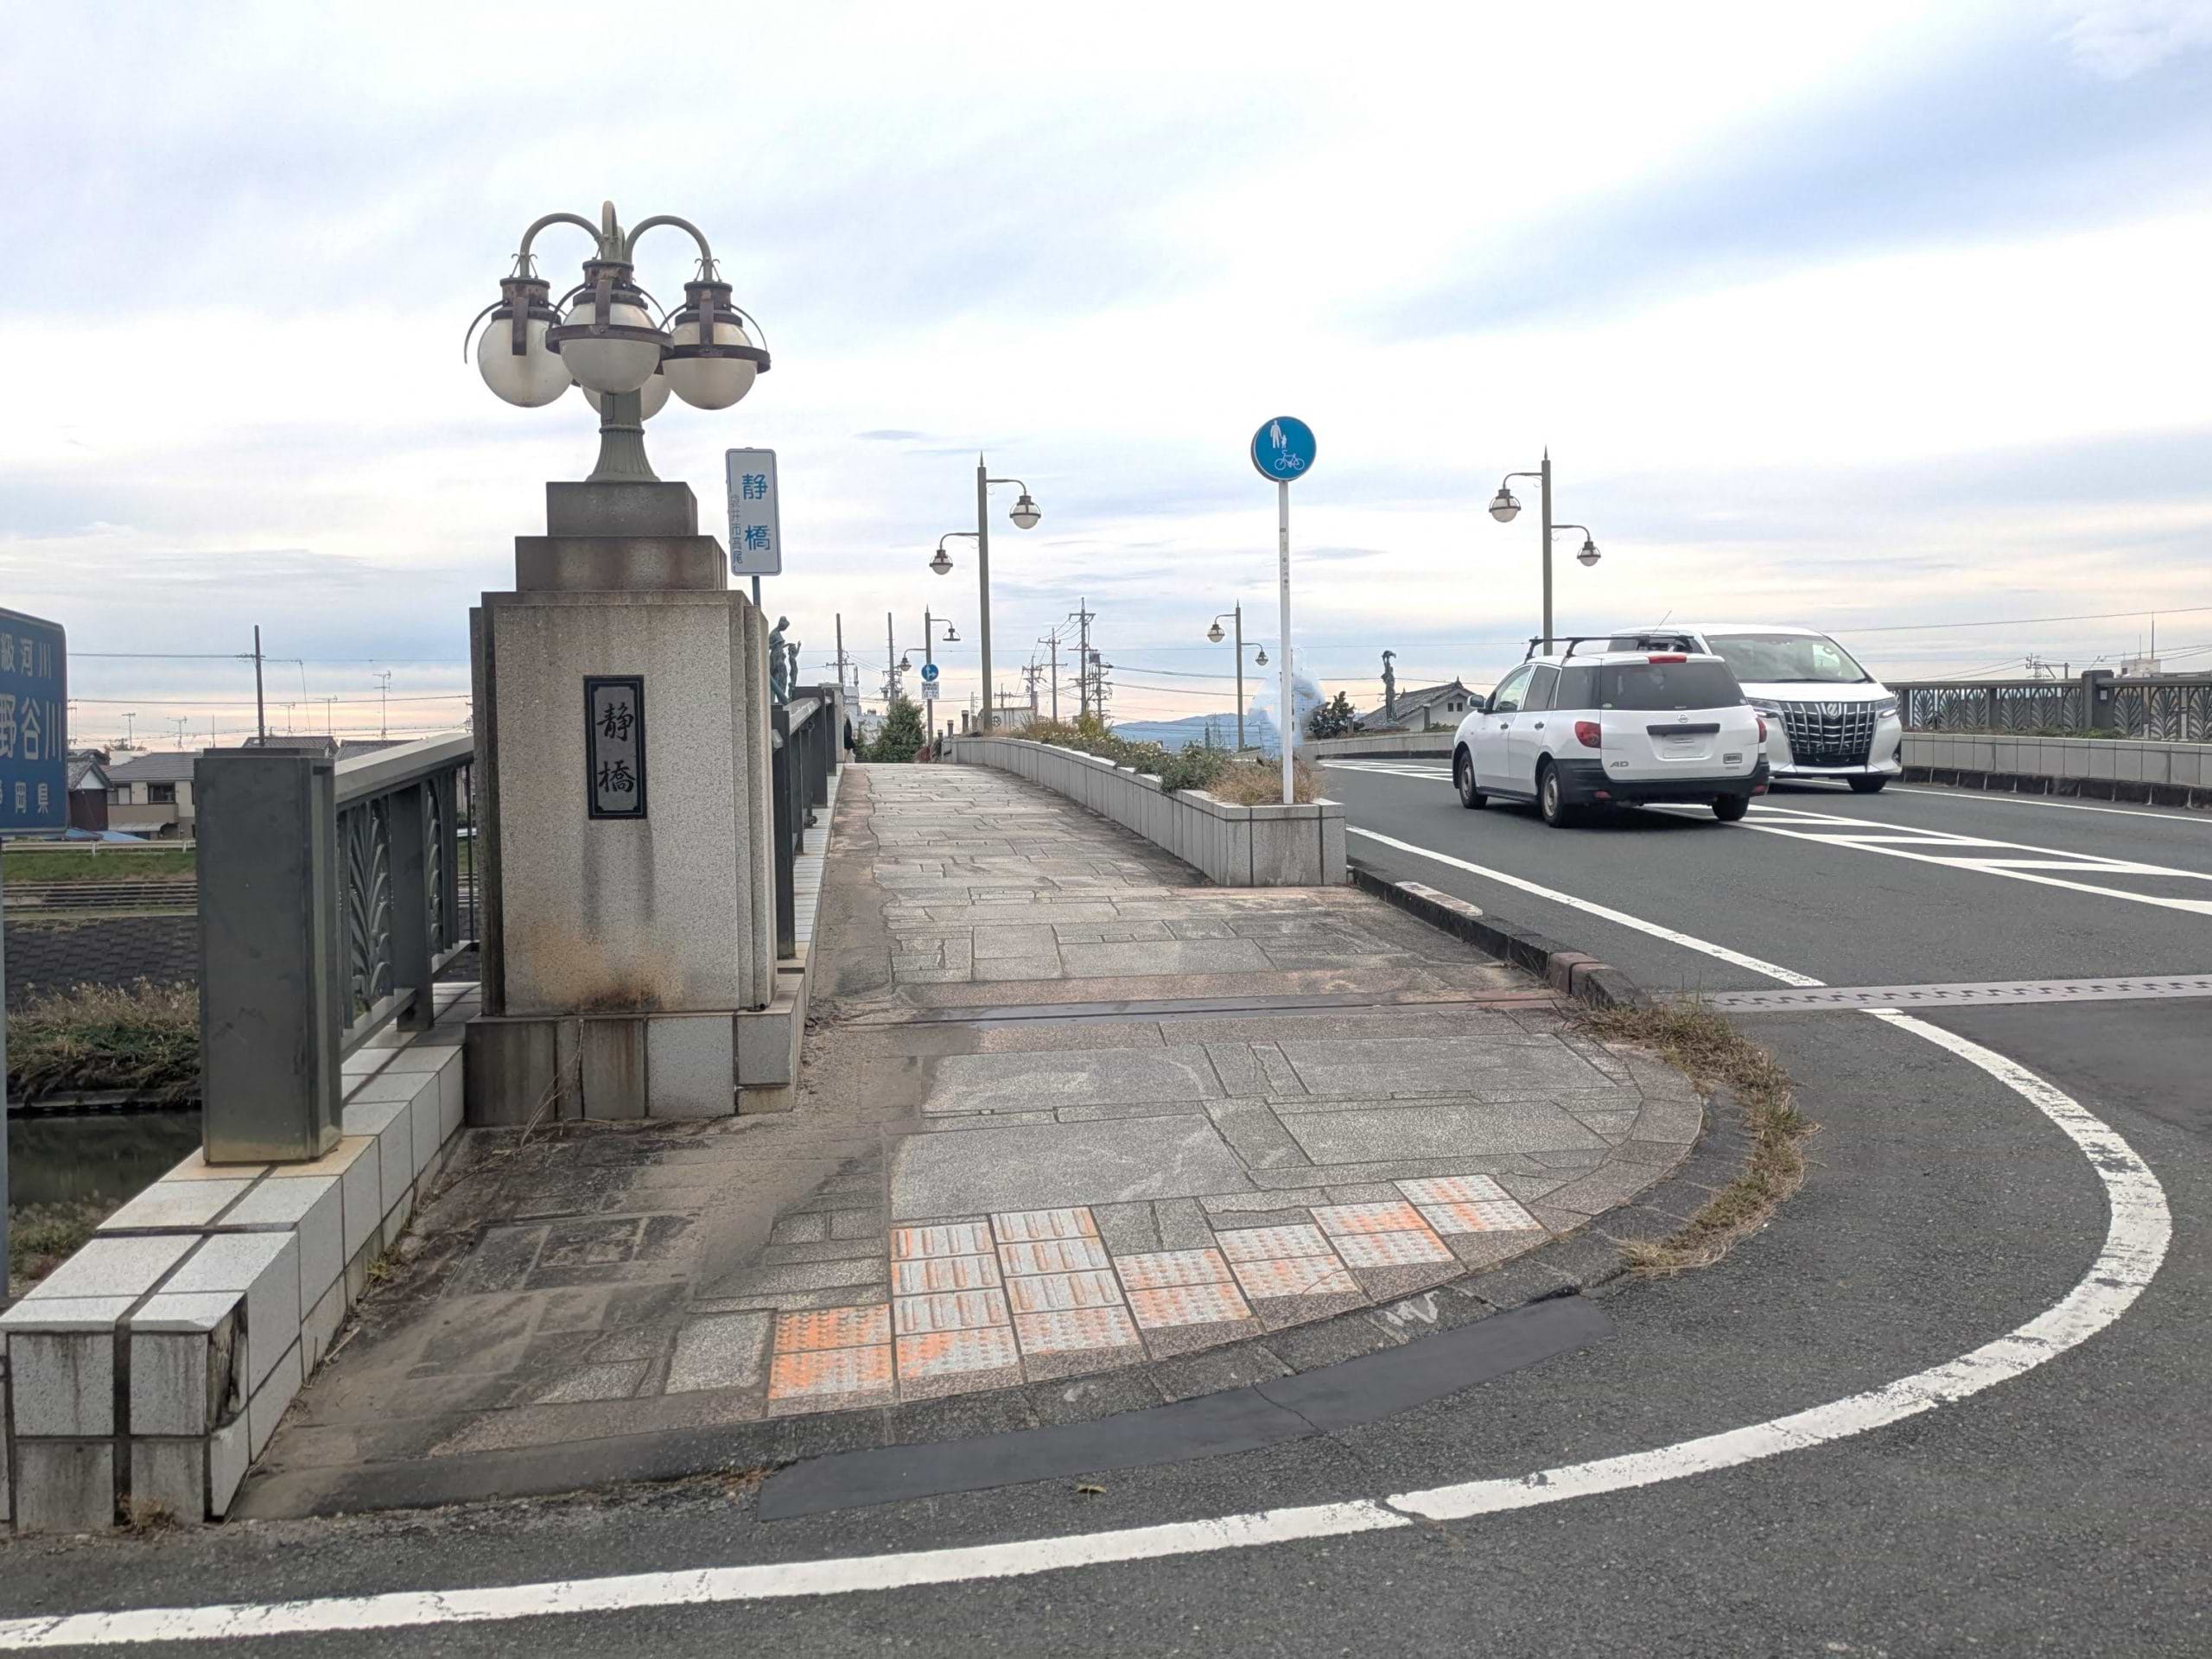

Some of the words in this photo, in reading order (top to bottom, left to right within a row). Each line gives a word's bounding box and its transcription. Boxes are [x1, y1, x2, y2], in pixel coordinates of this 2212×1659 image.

[741, 473, 771, 550] 静橋
[0, 694, 62, 762] 野谷川
[596, 702, 637, 793] 静橋
[0, 780, 48, 814] 岡県
